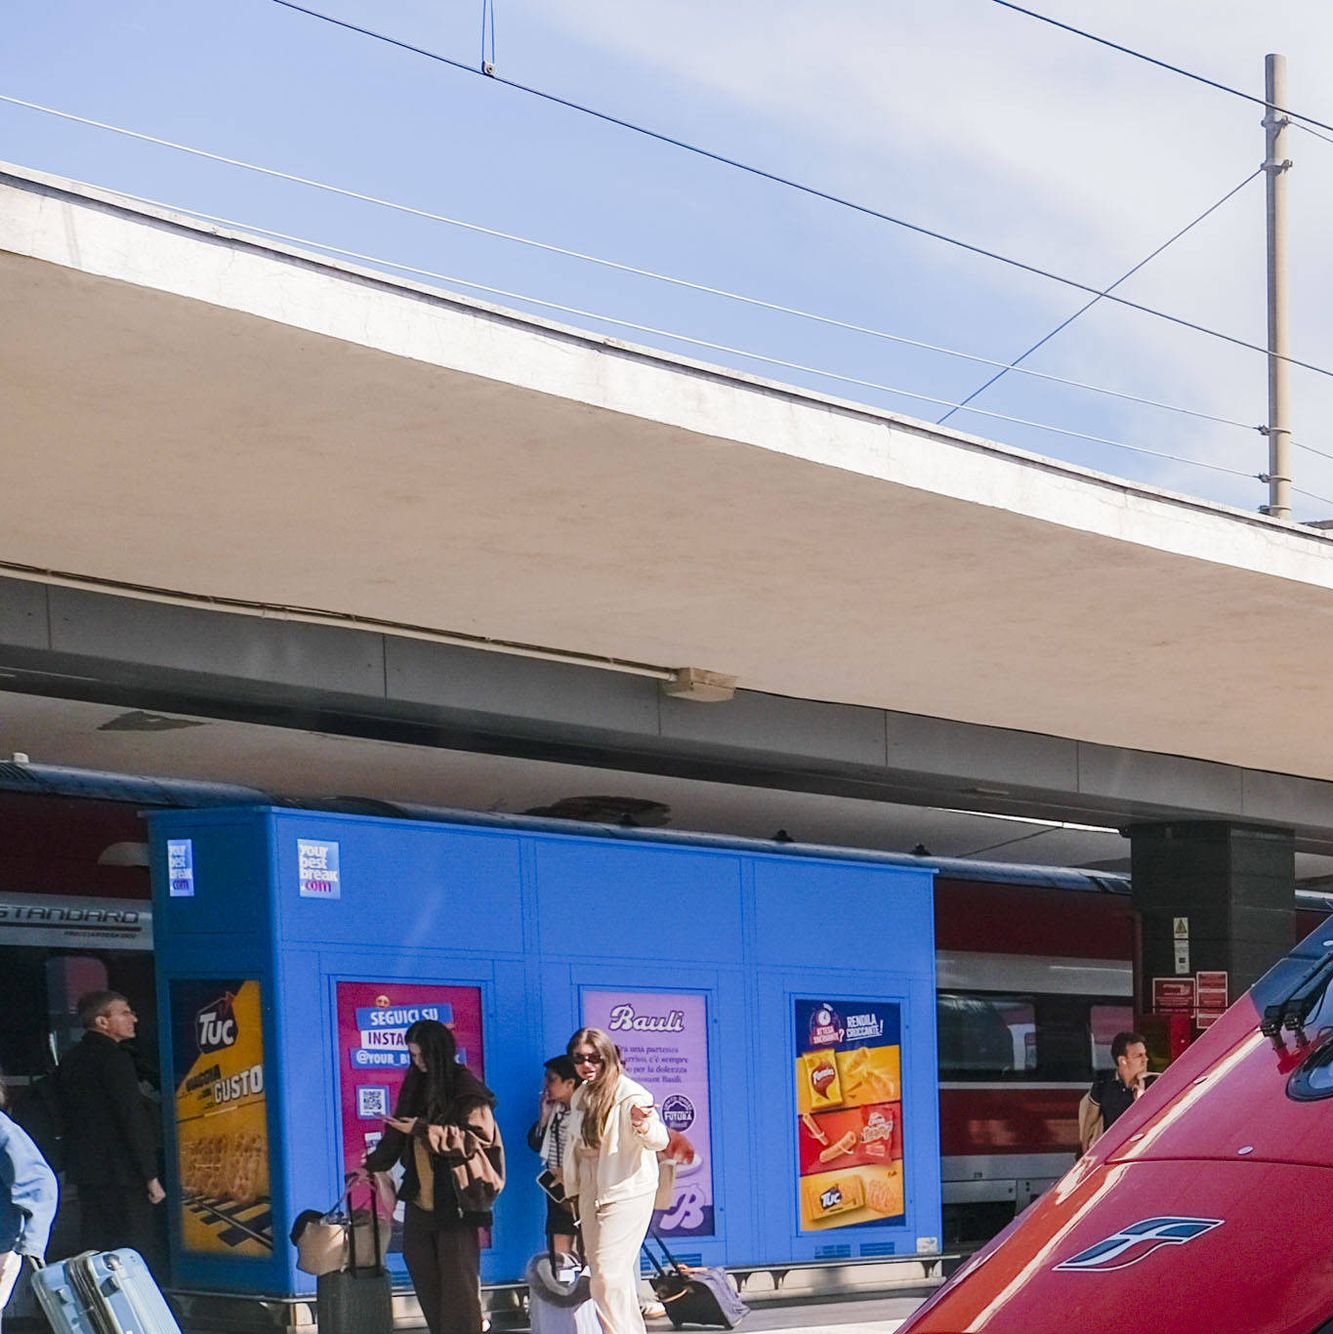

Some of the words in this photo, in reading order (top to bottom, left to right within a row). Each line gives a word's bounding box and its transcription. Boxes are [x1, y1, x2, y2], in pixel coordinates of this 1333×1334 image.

[299, 844, 328, 858] your
[300, 856, 328, 869] best
[300, 869, 338, 882] break
[301, 880, 332, 892] .com
[370, 1009, 420, 1026] SEGUICI
[421, 1008, 439, 1021] SU
[608, 1003, 685, 1033] Bauli
[846, 1013, 878, 1028] RENDILA
[199, 1011, 235, 1046] TUC
[368, 1032, 405, 1045] INSTA
[214, 1063, 264, 1104] GUSTO
